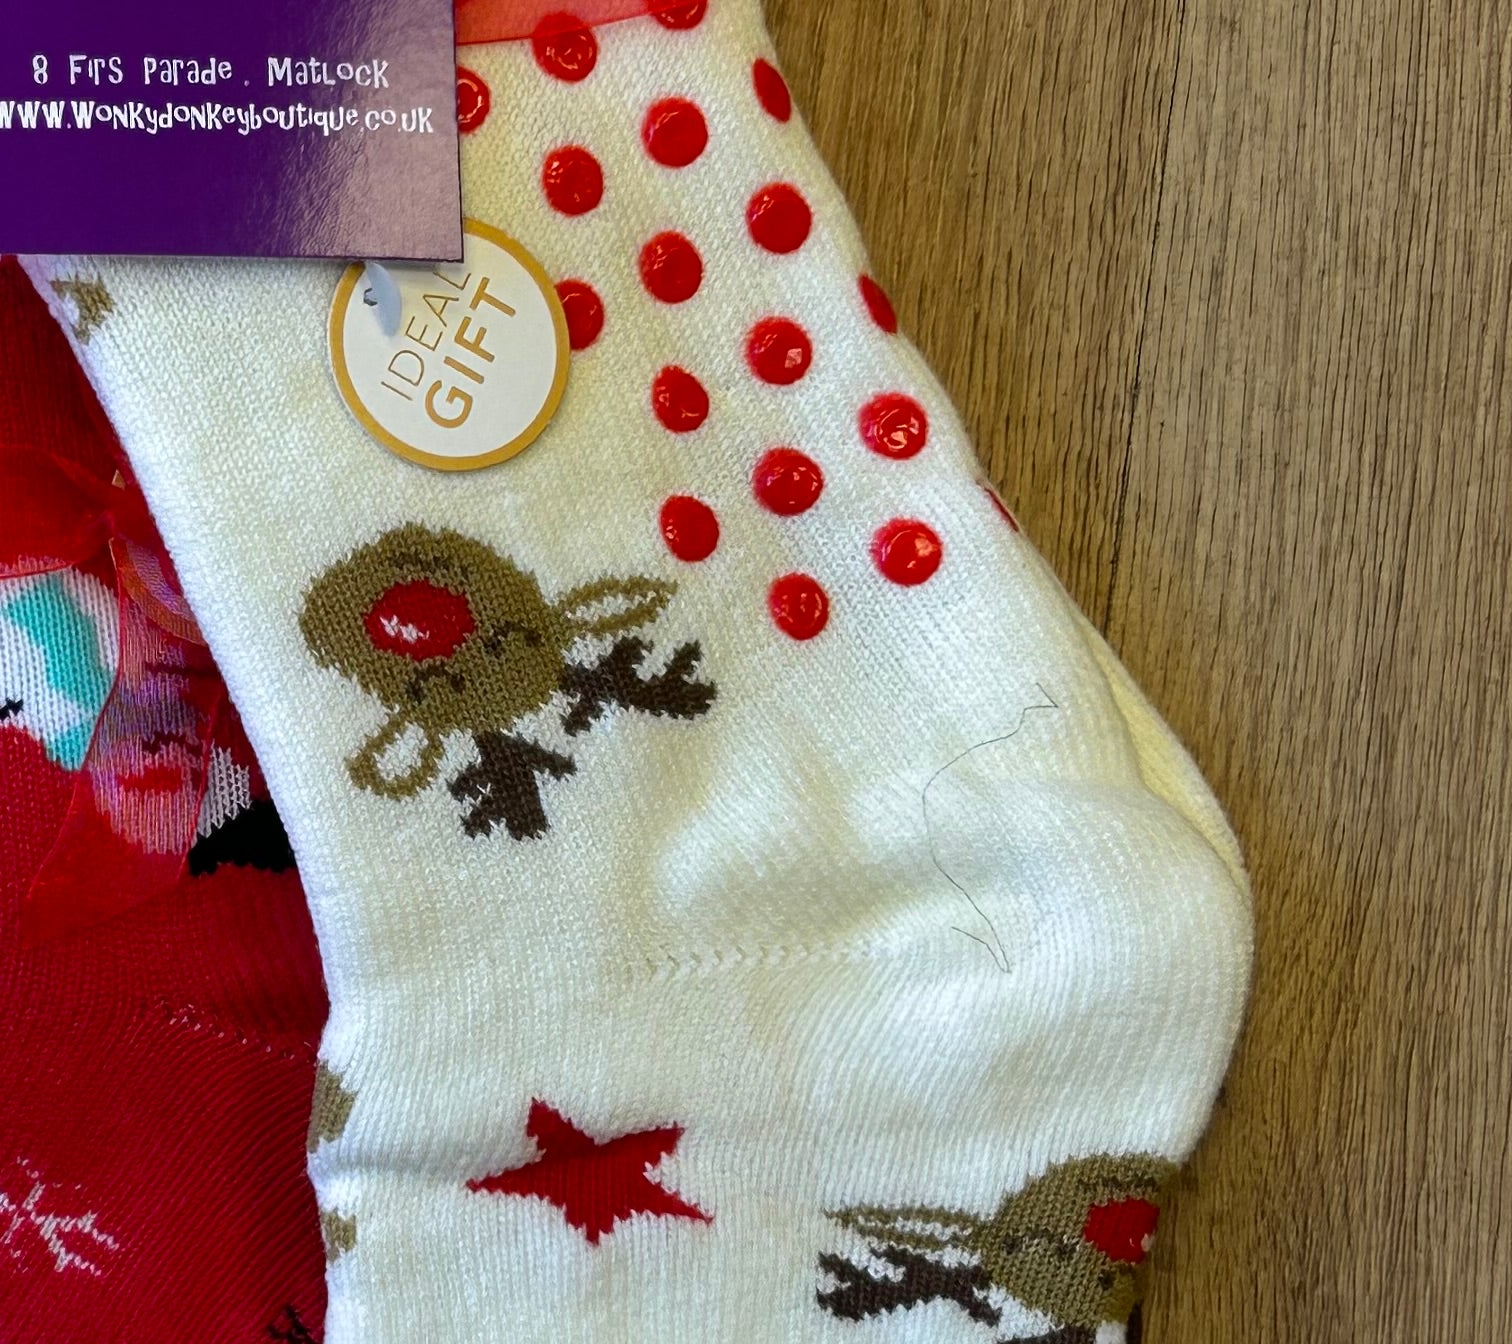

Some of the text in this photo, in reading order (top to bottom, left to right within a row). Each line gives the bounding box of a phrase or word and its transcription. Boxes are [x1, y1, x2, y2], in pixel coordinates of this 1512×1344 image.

[32, 54, 49, 84] 8
[69, 54, 124, 85] Firs
[267, 57, 390, 89] Matlock
[380, 271, 472, 401] IDEAL
[424, 276, 516, 429] GIFT
